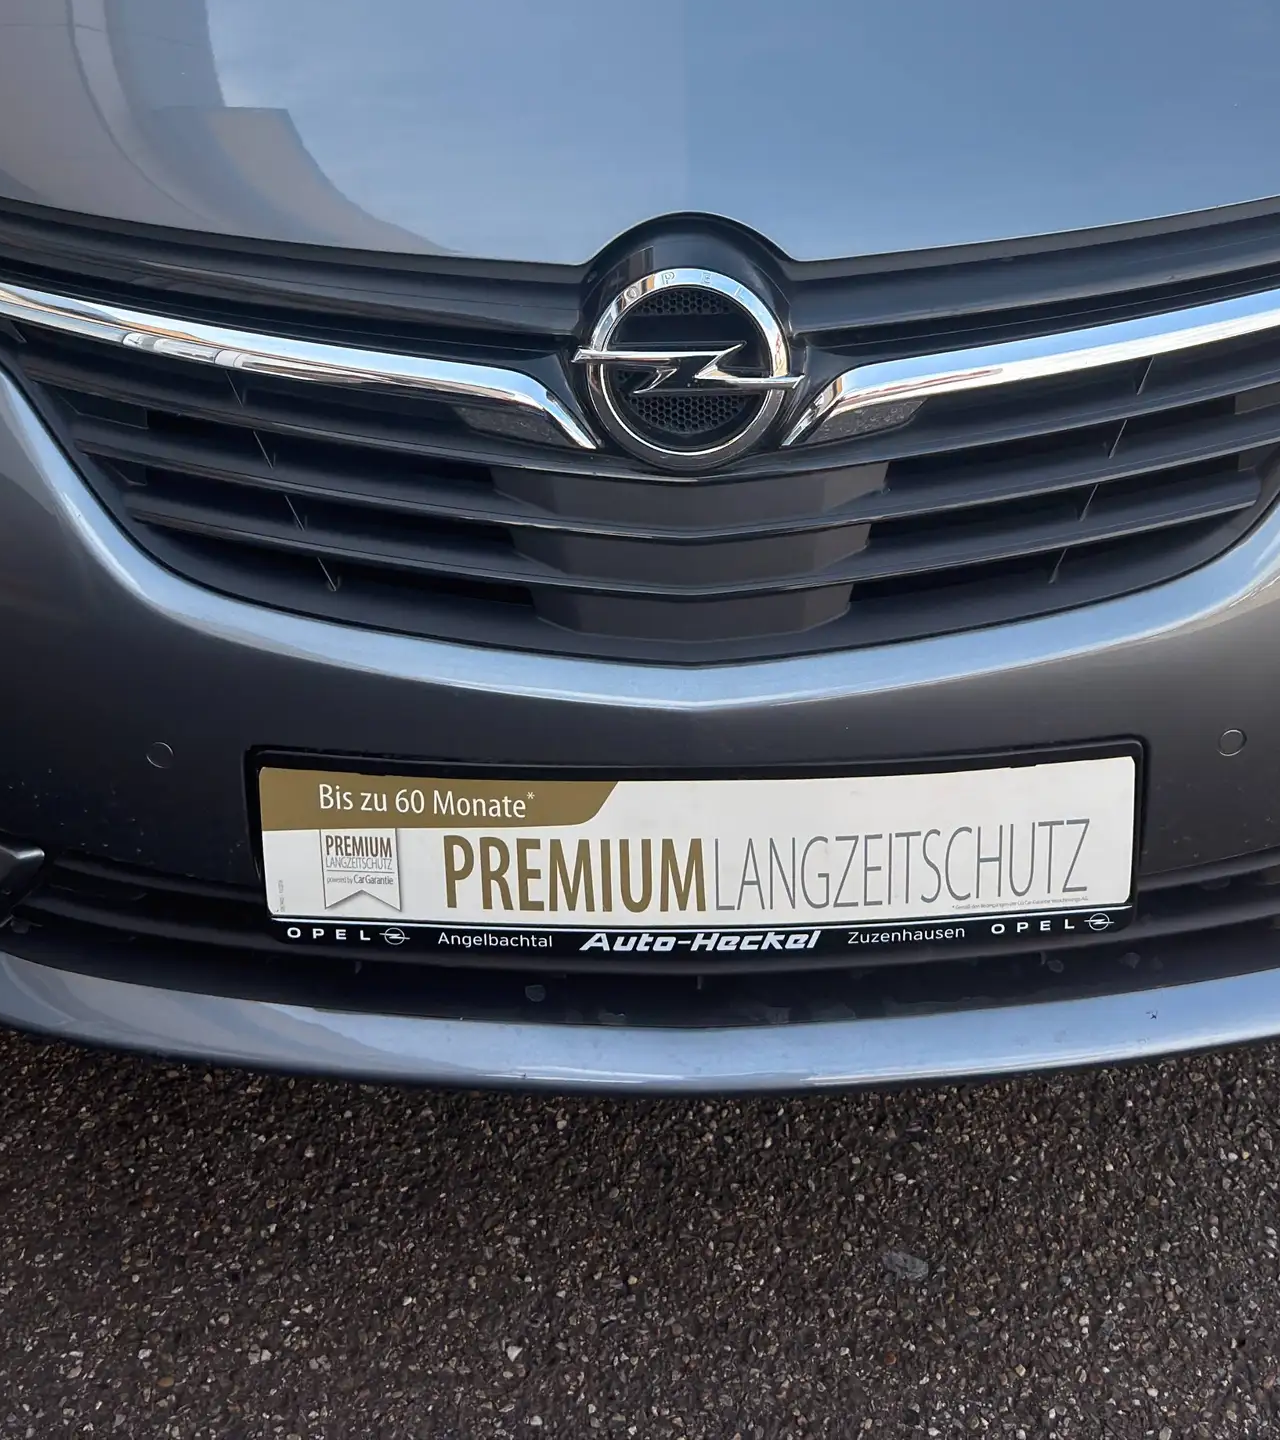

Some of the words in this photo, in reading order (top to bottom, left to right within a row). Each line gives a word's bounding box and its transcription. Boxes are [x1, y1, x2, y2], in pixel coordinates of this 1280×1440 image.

[624, 271, 750, 303] OPEL
[319, 783, 353, 810] Bis
[360, 791, 388, 813] zu
[394, 789, 425, 814] 60
[325, 835, 393, 858] PREMIUM
[325, 856, 393, 871] LANGZEITSCHUTZ
[326, 876, 347, 885] powered
[353, 874, 394, 885] CarGarantie
[287, 927, 371, 941] OPEL
[437, 931, 553, 948] Angelbachtal
[579, 930, 822, 952] Auto-Heckel
[847, 925, 966, 946] Zuzenhausen
[990, 919, 1075, 935] OPEL
